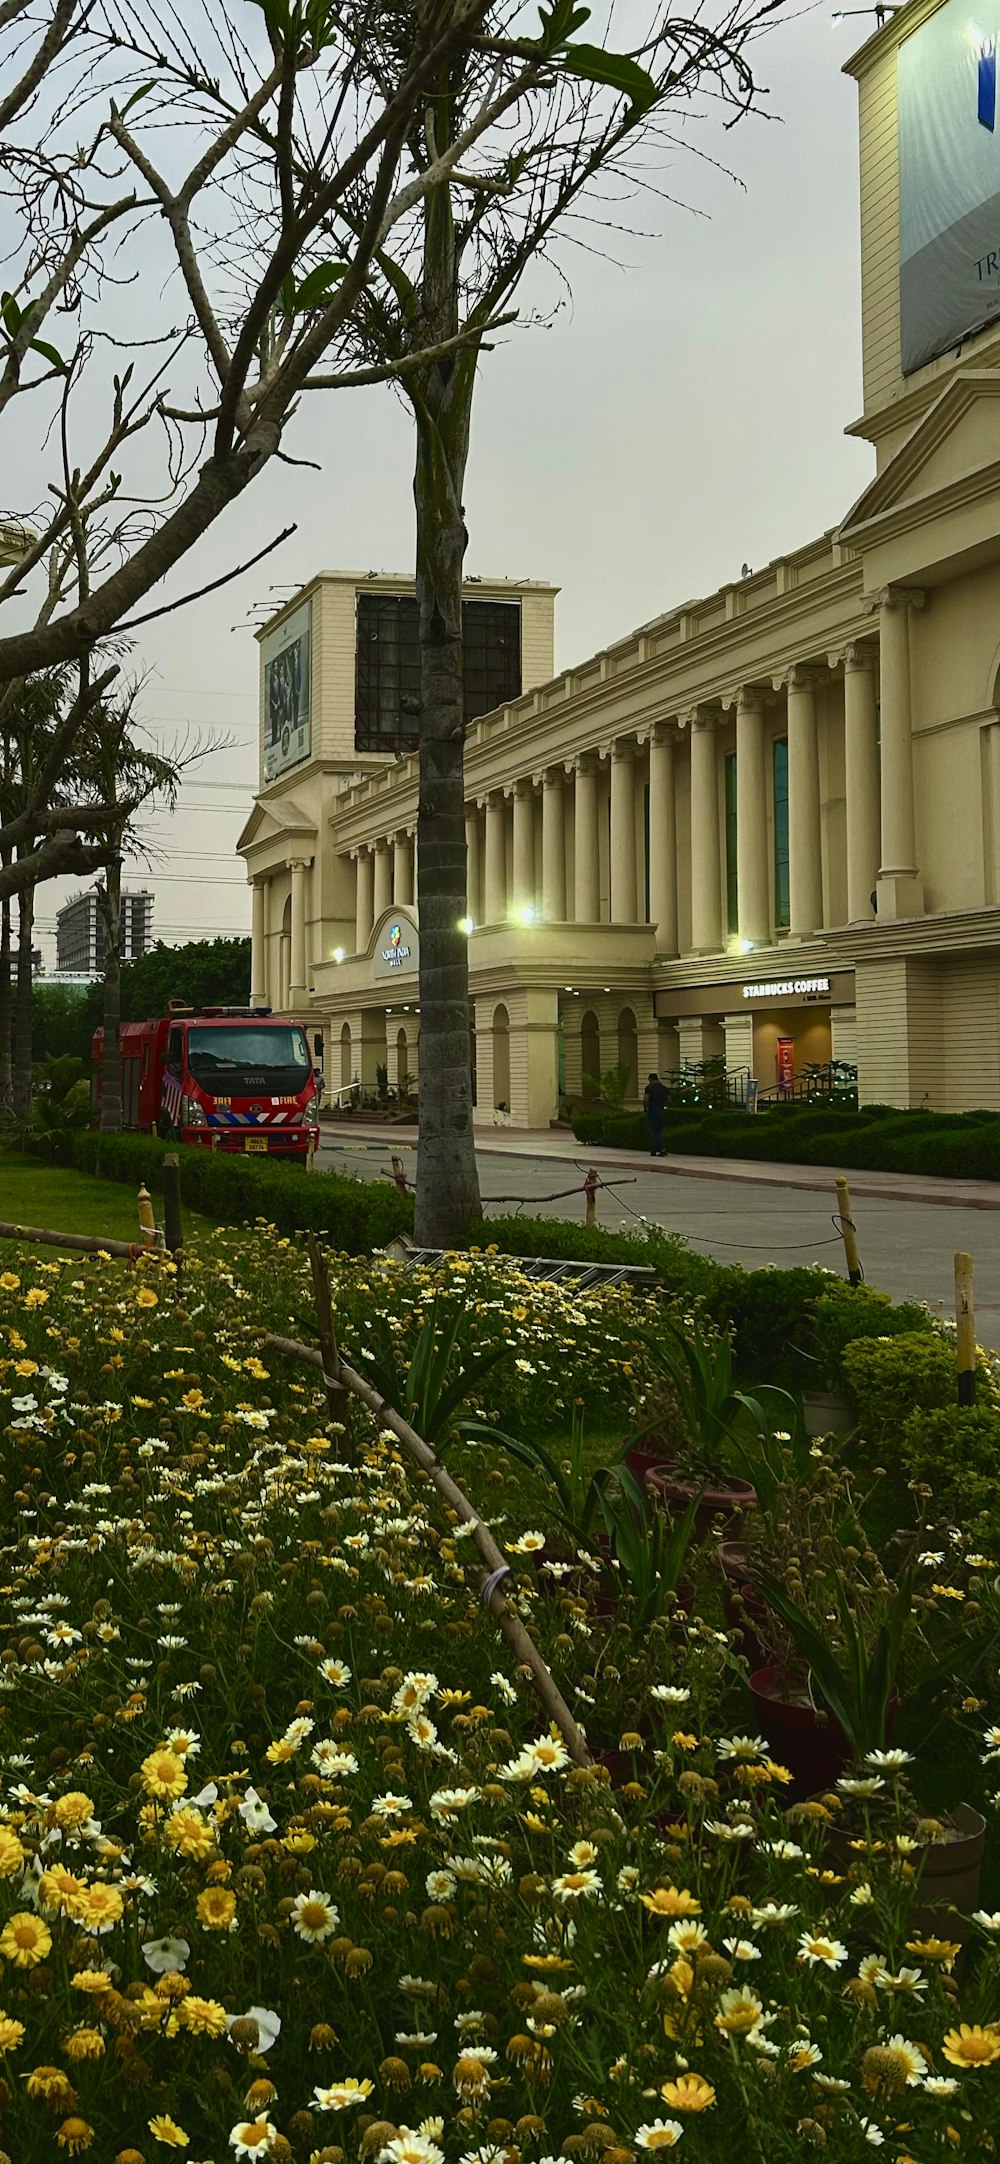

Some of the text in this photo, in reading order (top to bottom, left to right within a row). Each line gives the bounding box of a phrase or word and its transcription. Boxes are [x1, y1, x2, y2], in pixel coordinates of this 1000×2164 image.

[742, 978, 830, 999] STARBUCKS COFFEE
[243, 1077, 266, 1085] TATA
[279, 1096, 298, 1106] FIRE
